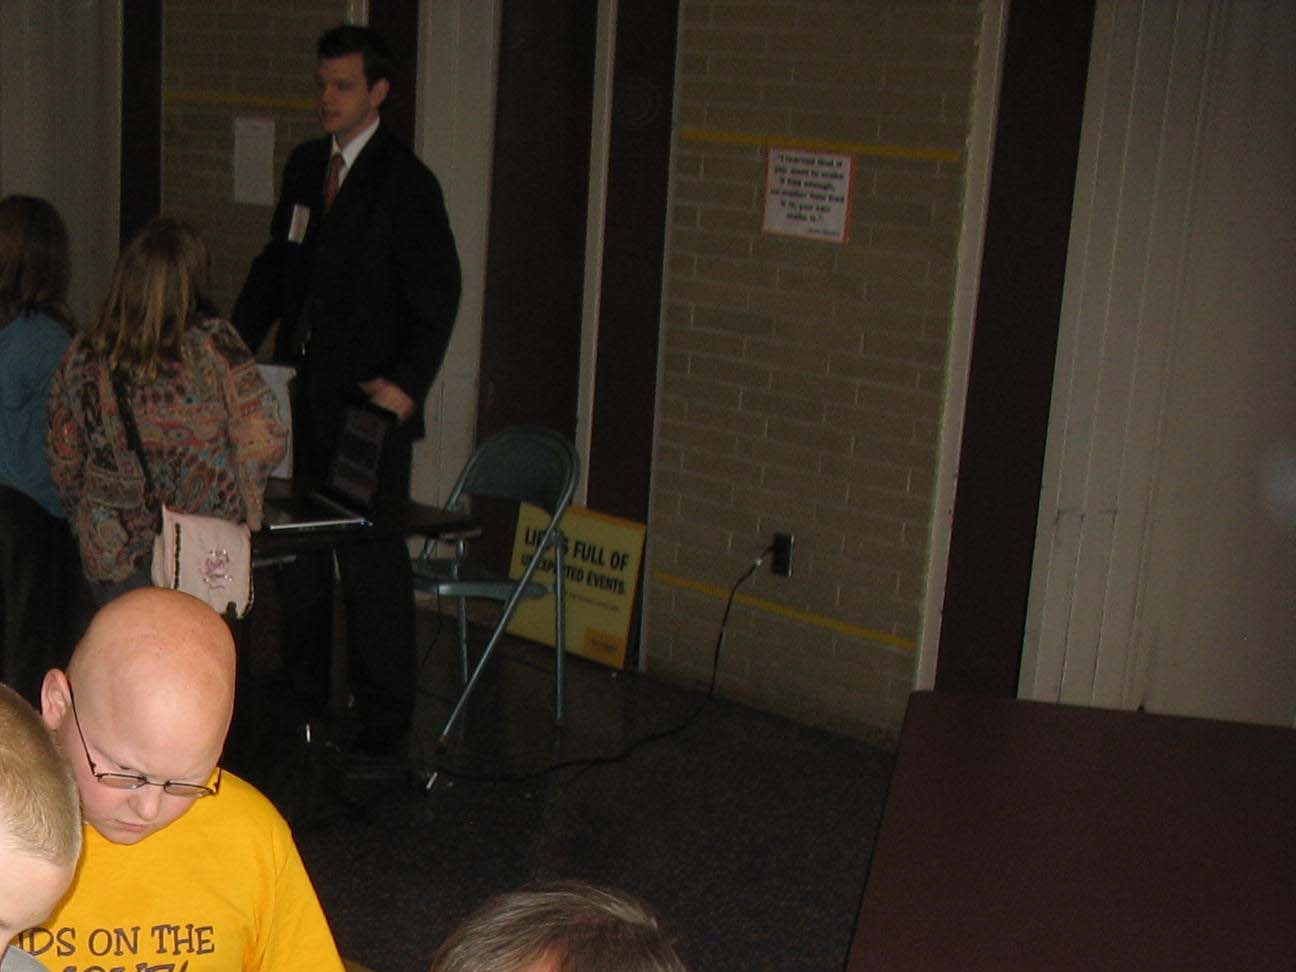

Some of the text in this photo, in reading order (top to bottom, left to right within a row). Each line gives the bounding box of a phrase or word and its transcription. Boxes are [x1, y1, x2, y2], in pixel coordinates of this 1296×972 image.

[573, 540, 605, 567] FULL
[610, 552, 630, 571] OF
[587, 572, 625, 594] EVENTS
[88, 926, 140, 957] ON
[151, 924, 215, 956] THE
